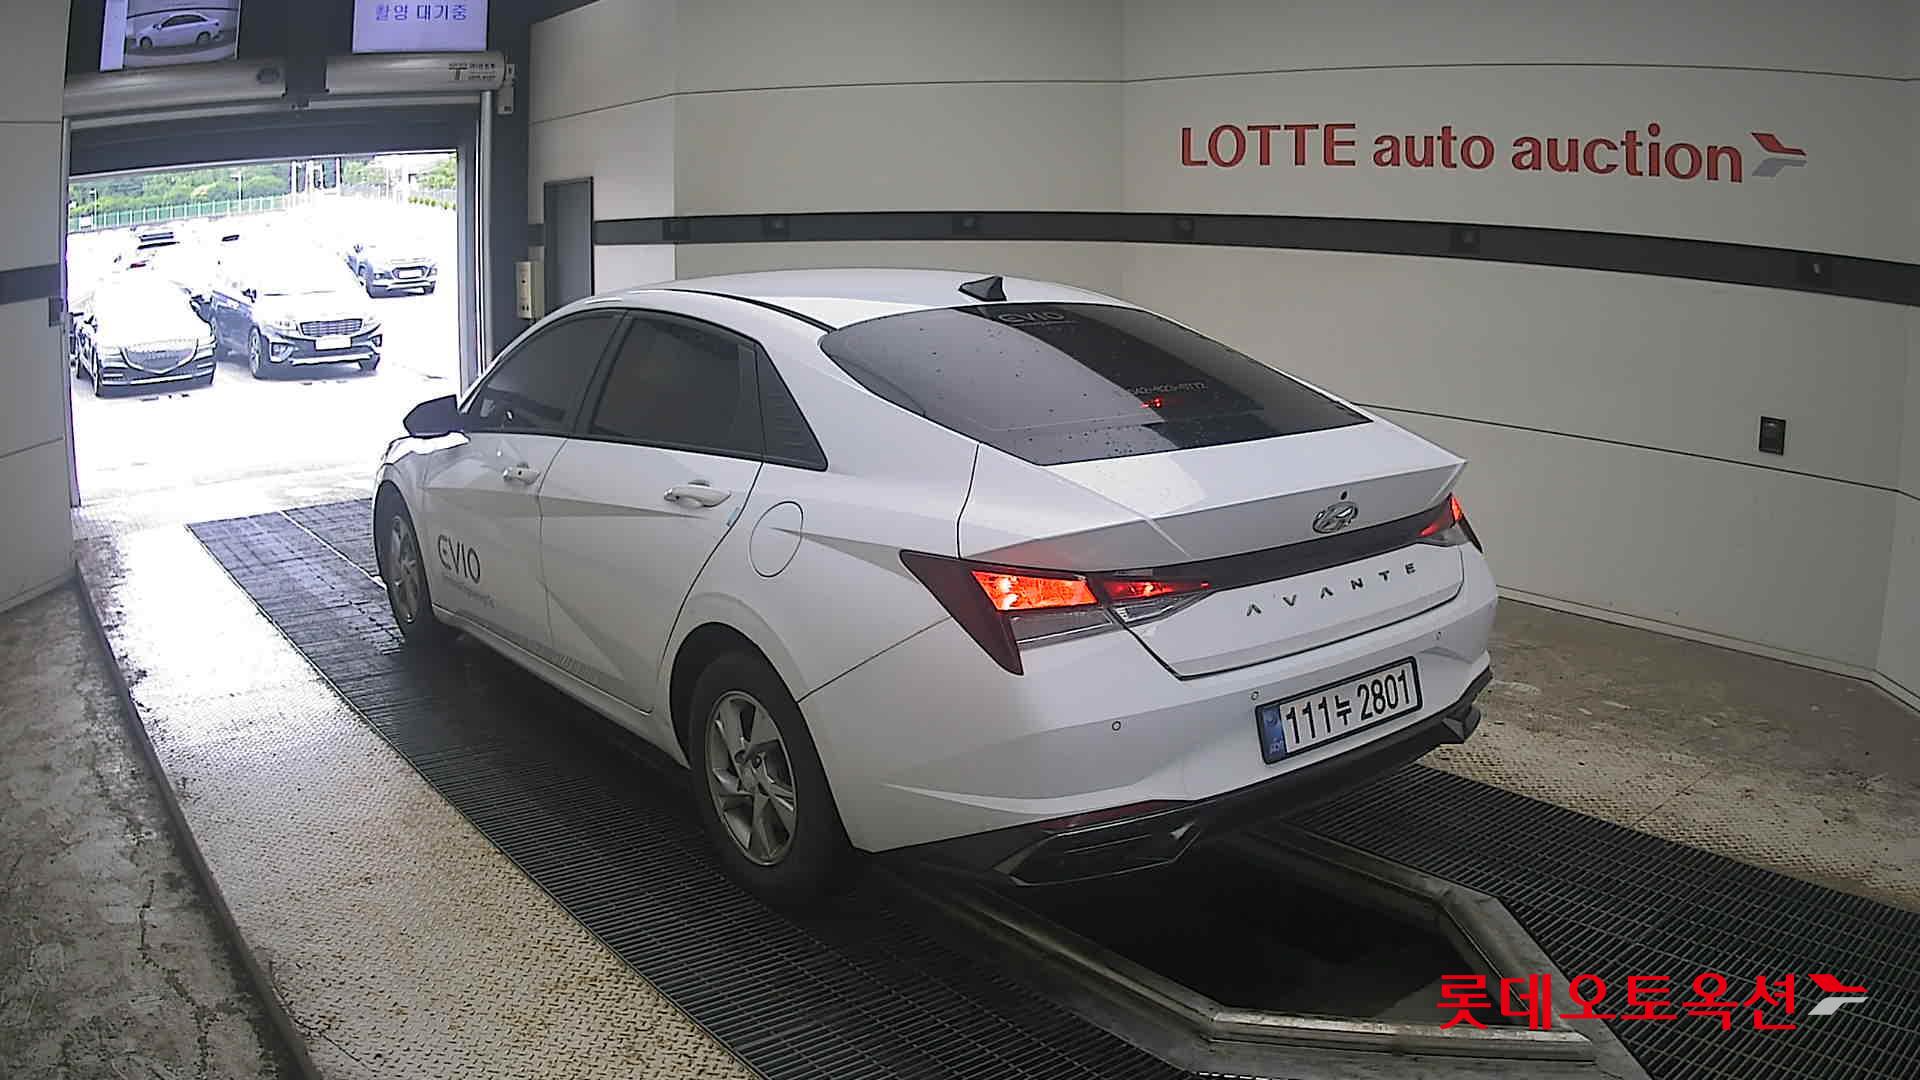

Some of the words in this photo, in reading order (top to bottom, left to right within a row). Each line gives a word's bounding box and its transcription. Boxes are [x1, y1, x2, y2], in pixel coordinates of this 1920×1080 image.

[416, 4, 468, 21] 대기중
[1181, 123, 1357, 168] LOTTE
[1372, 125, 1495, 170] auto
[1510, 122, 1743, 183] auction
[437, 533, 481, 584] EVIO
[1245, 562, 1417, 617] AVANTE
[1286, 695, 1353, 745] 111누
[1356, 669, 1412, 721] 2801
